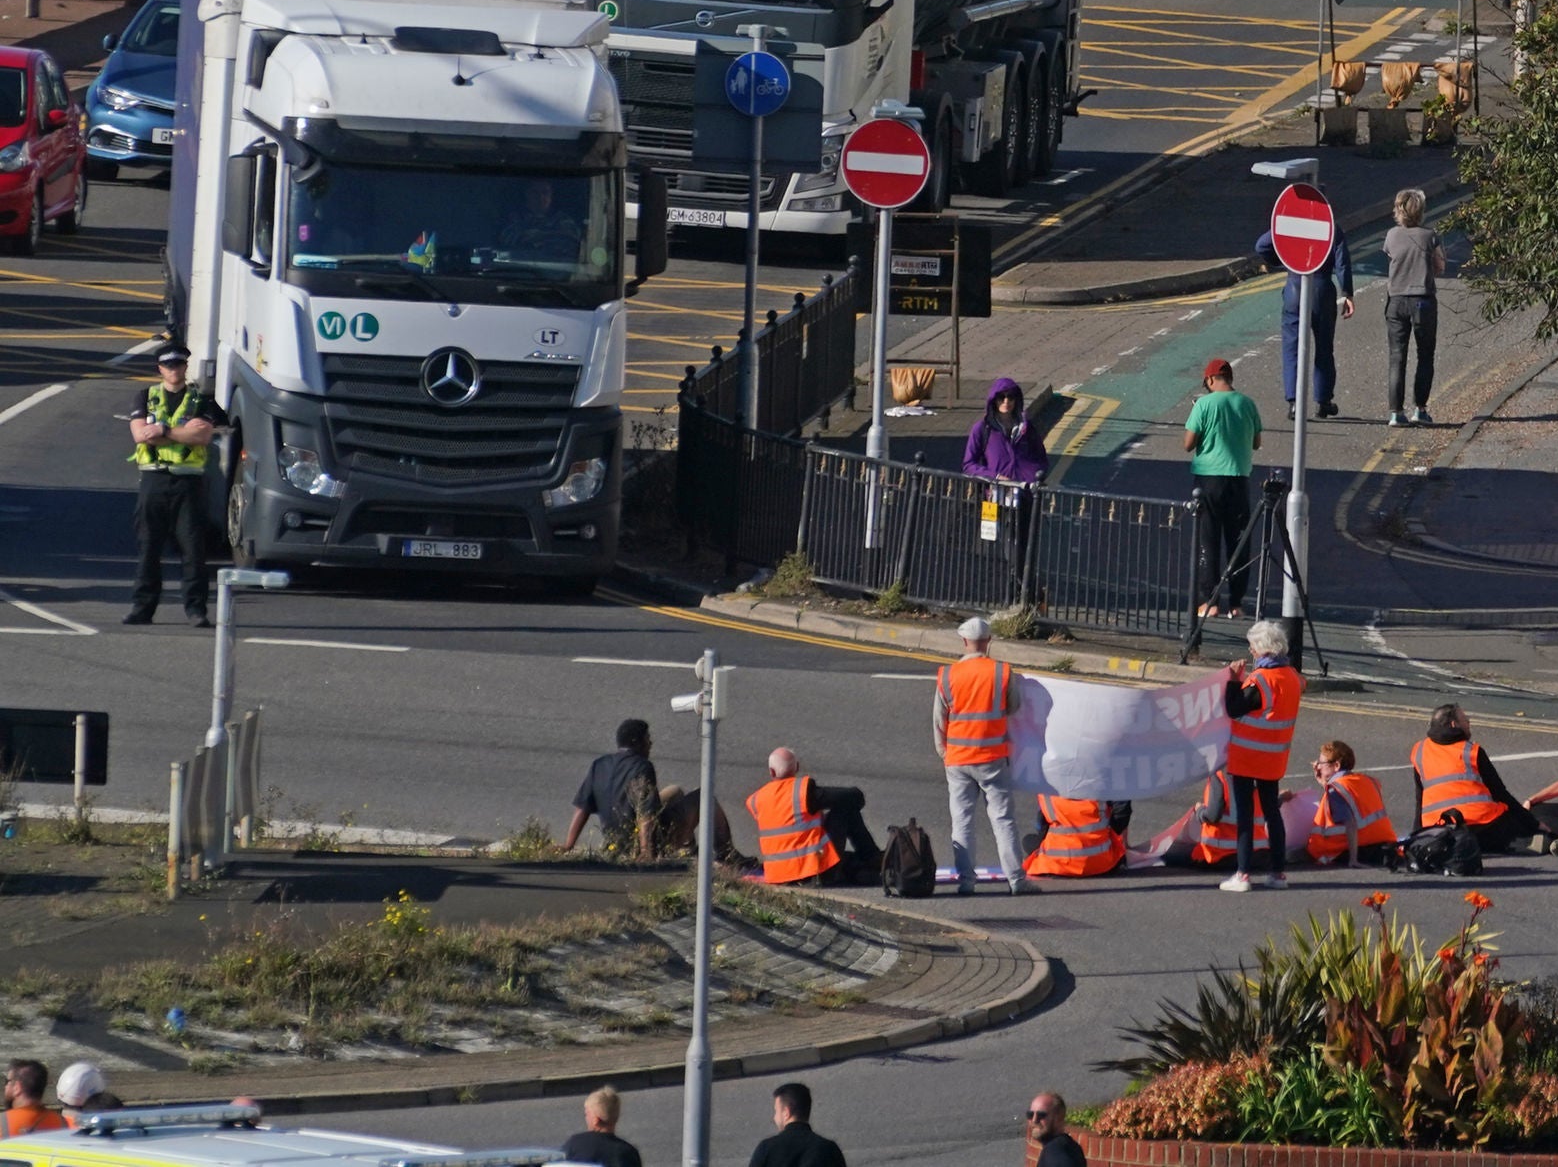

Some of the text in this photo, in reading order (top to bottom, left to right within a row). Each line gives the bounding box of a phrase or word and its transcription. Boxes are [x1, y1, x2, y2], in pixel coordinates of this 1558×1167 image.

[687, 210, 723, 224] 63804
[355, 315, 373, 339] L
[540, 331, 560, 344] LT
[413, 543, 479, 557] JRL 883
